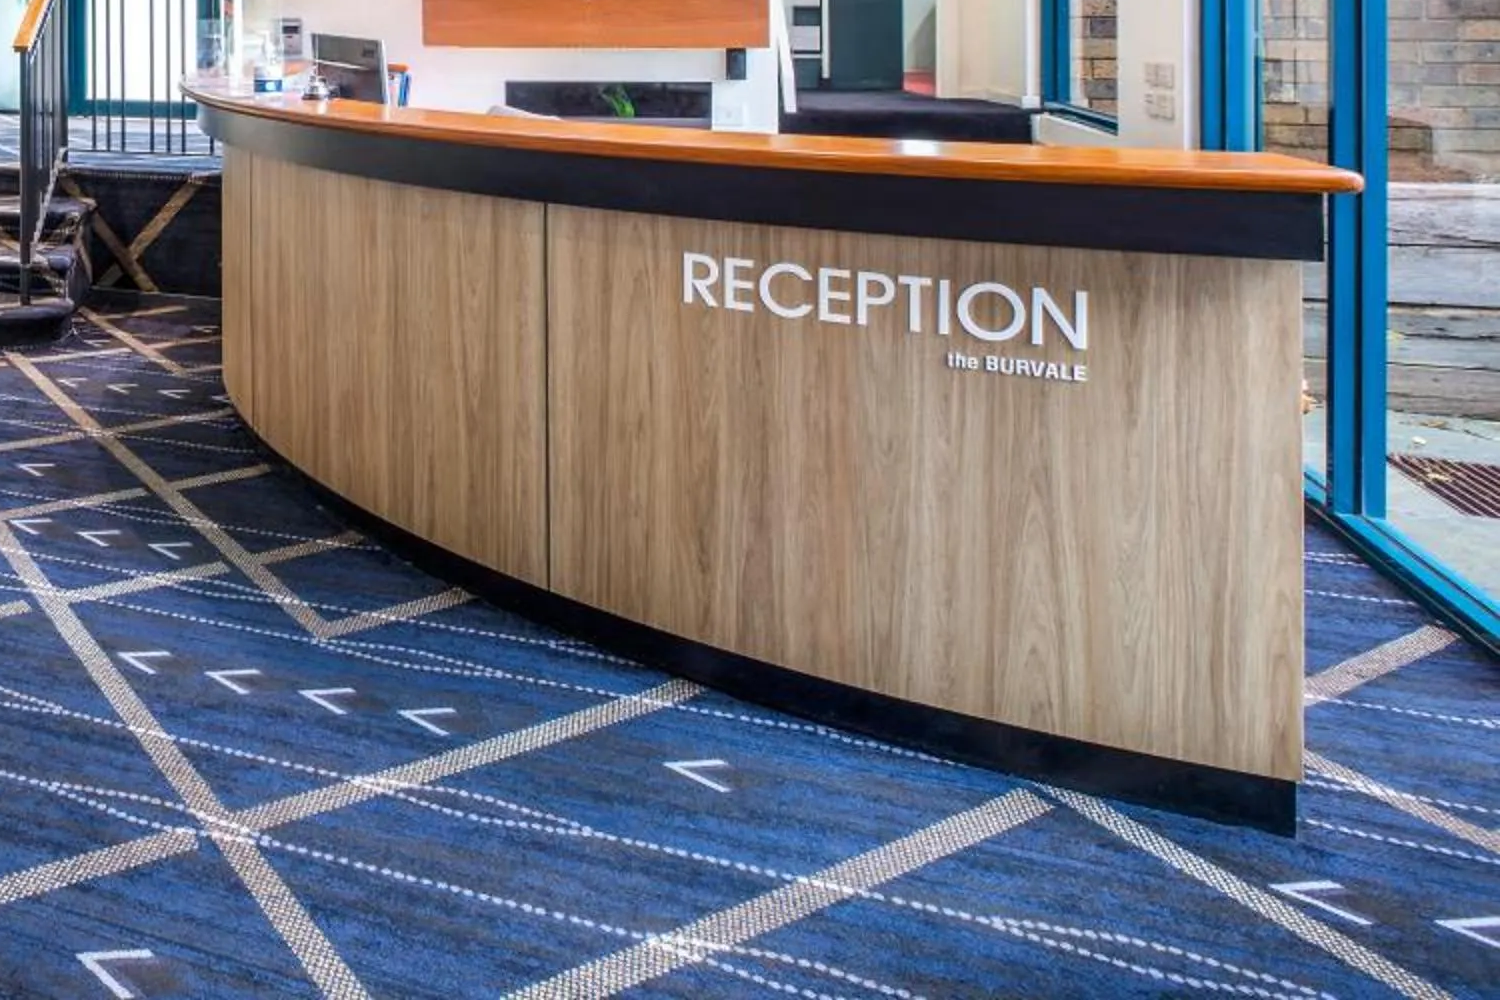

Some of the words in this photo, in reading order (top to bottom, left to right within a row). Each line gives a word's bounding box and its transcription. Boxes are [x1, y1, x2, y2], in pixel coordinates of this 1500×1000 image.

[682, 251, 1089, 350] RECEPTION
[946, 351, 979, 370] the
[985, 354, 1088, 383] BURVALE
